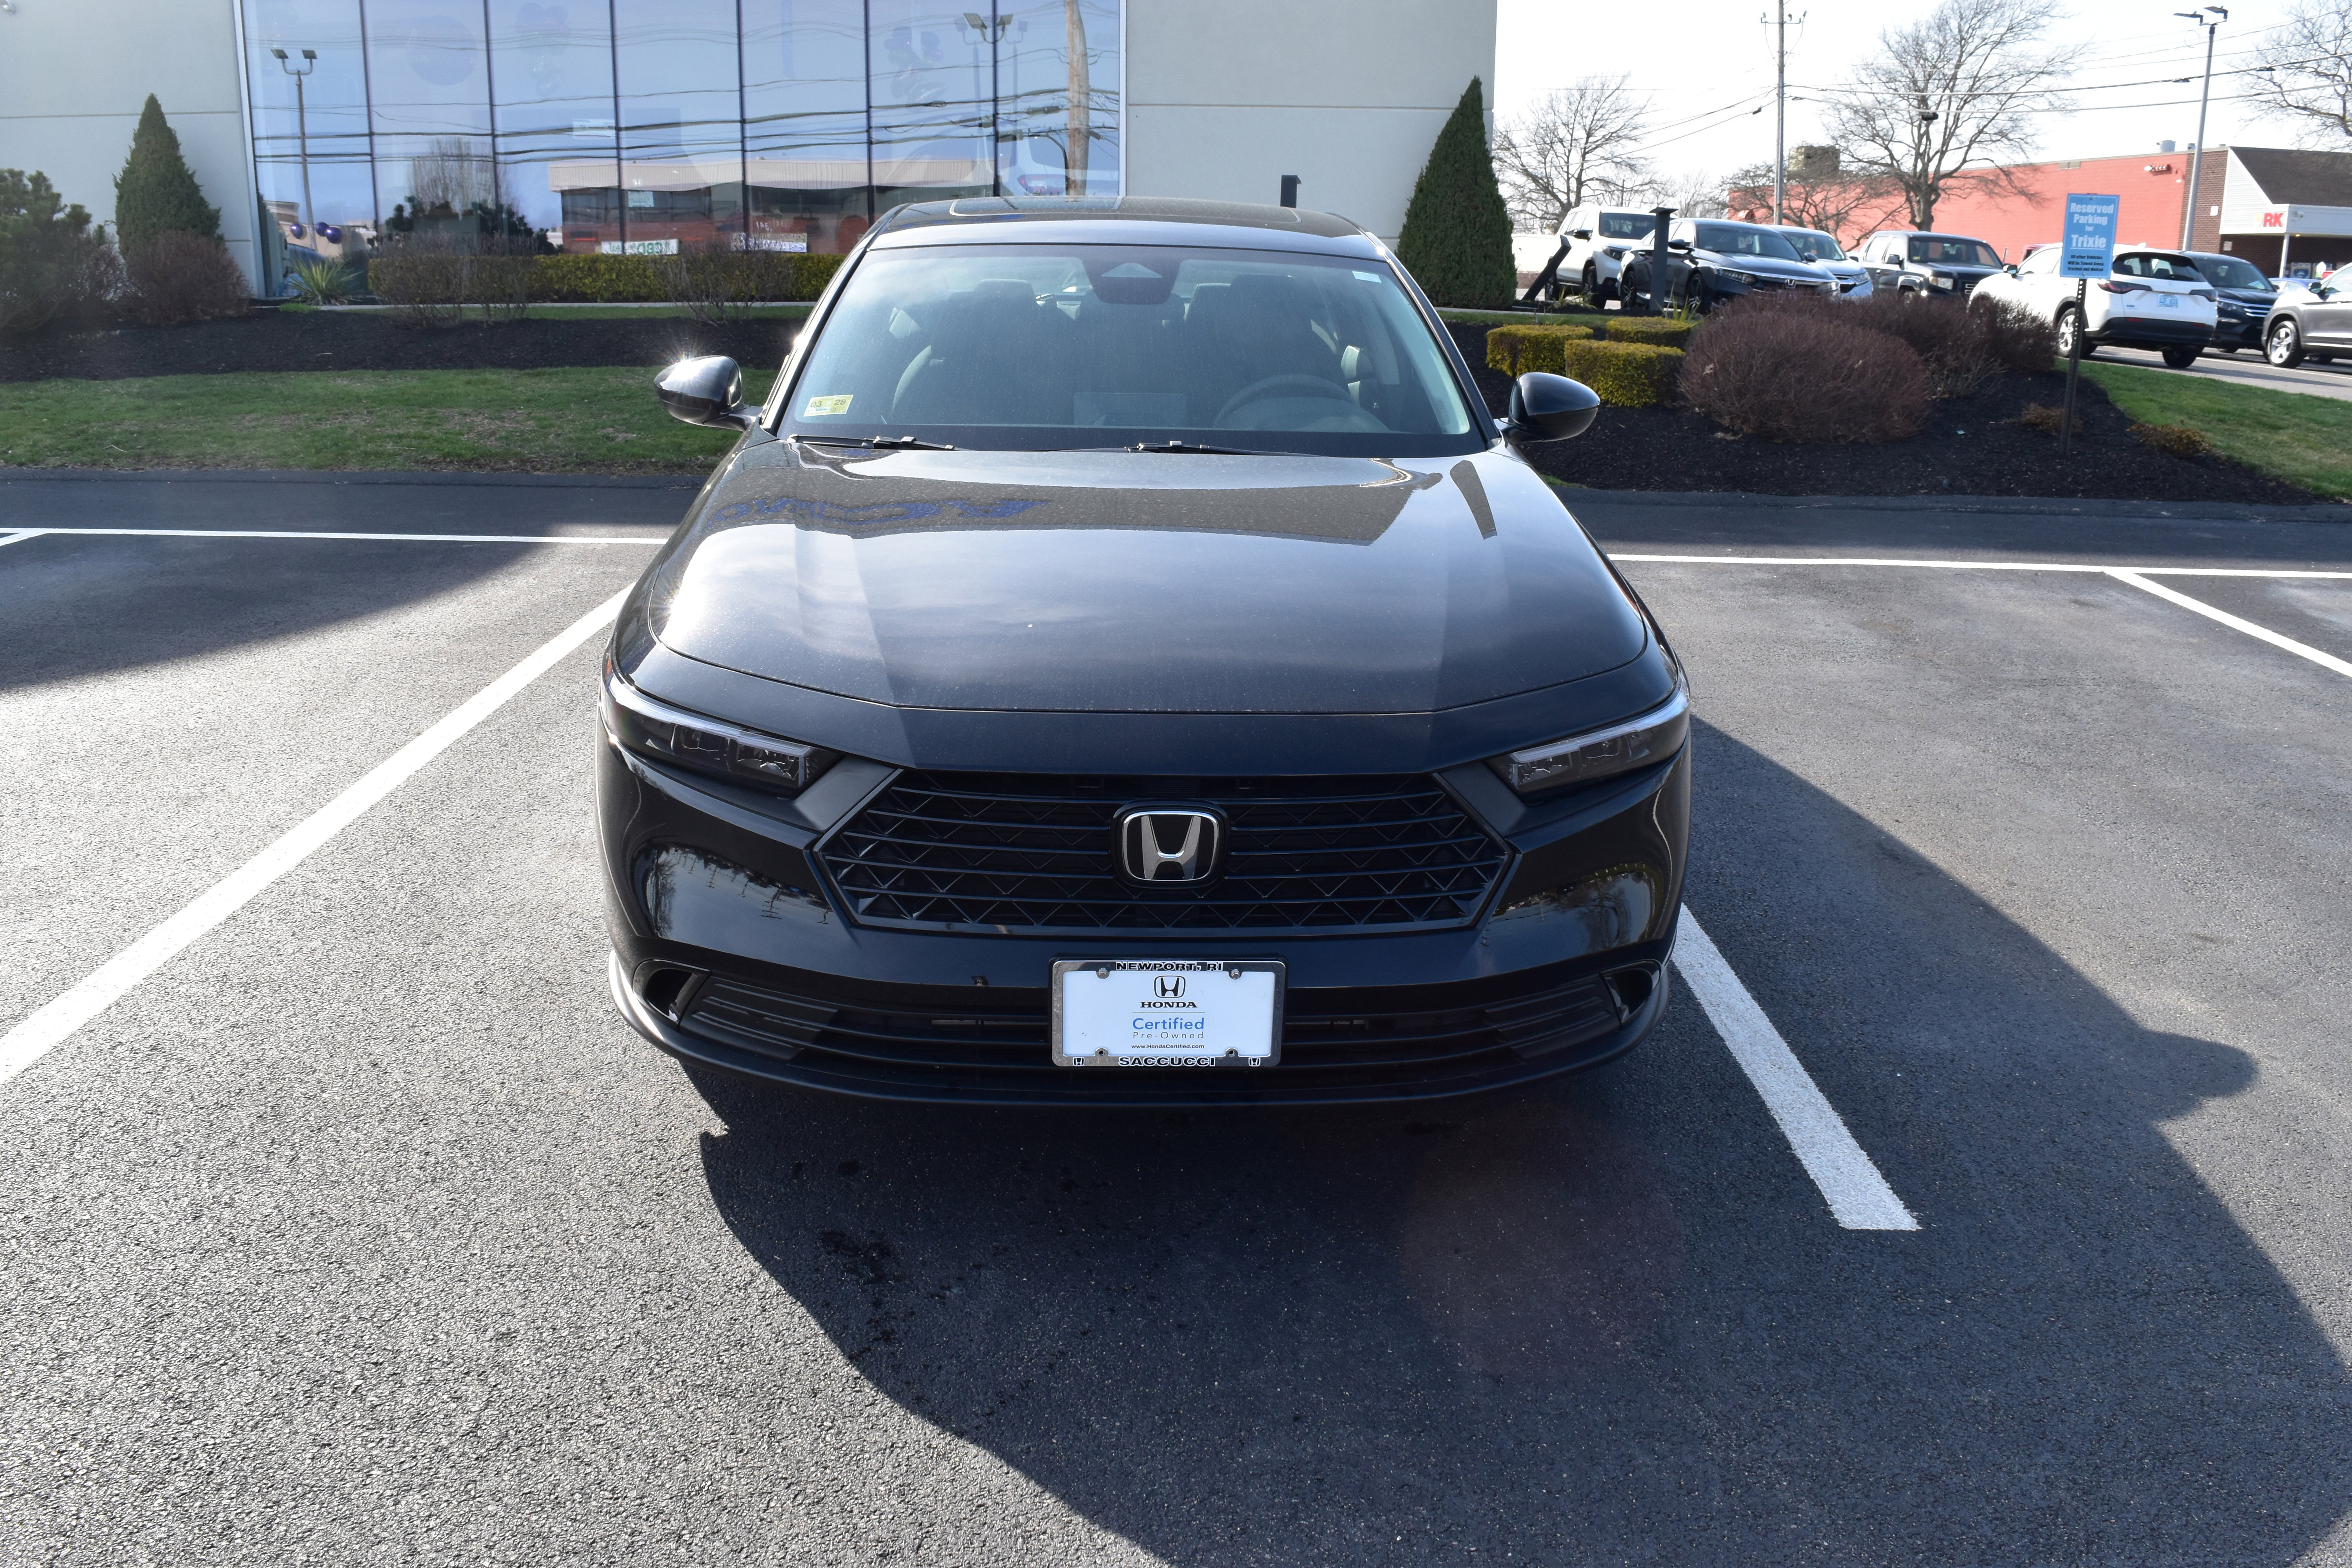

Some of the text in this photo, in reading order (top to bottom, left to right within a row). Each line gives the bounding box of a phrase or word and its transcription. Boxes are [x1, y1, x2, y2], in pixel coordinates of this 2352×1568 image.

[2070, 203, 2114, 214] Reserved
[2074, 214, 2108, 225] Parking
[2263, 213, 2284, 227] RK
[2071, 234, 2107, 248] Trixie
[1116, 961, 1223, 971] NEWPORT, RI
[1132, 1017, 1205, 1030] Certified
[1118, 1056, 1216, 1067] SACCUCCI
